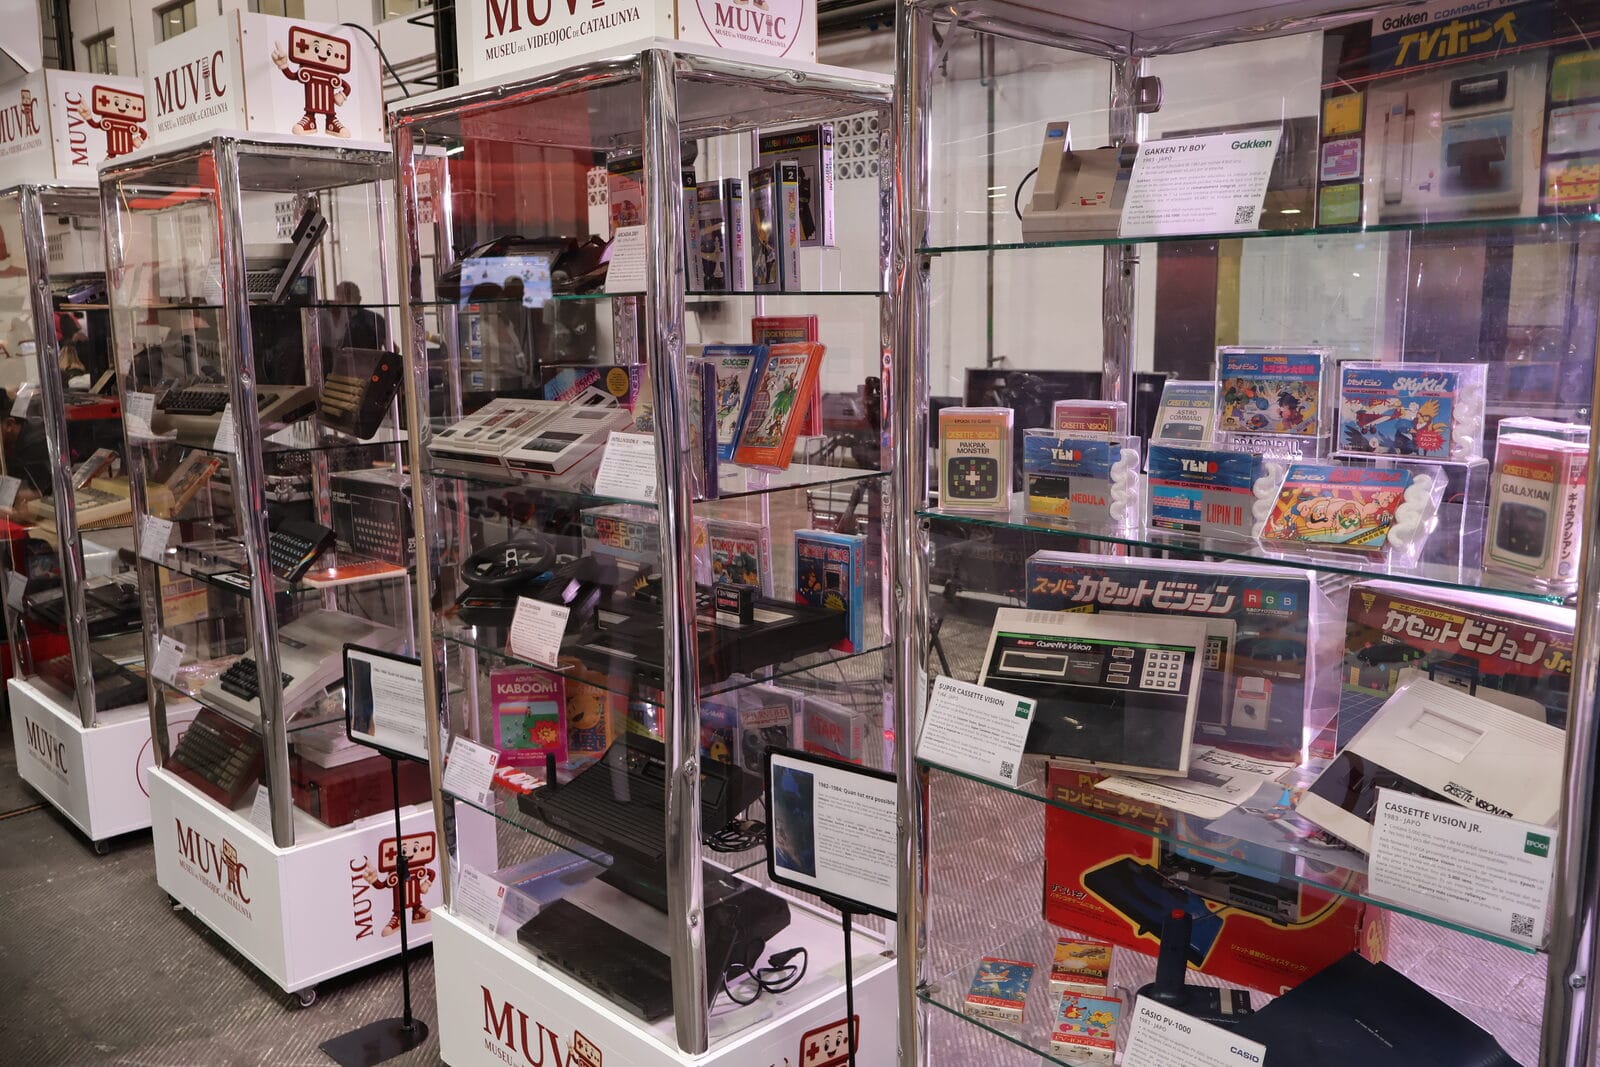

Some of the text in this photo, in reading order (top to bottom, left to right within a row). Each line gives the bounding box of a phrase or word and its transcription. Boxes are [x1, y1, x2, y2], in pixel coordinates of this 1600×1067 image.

[1382, 12, 1428, 31] Gakken
[485, 42, 517, 61] MUSEU
[527, 26, 572, 49] VIDEOJOC
[579, 6, 640, 36] CATALUNYA
[1144, 146, 1176, 156] GAKKEN
[1189, 143, 1206, 152] BOY
[1231, 139, 1272, 150] Gakken
[788, 171, 794, 180] 2
[1502, 483, 1551, 501] GALAXIAN
[1206, 503, 1243, 526] LUPIN III
[799, 543, 849, 562] DONKEY KONG
[1032, 577, 1075, 595] スーパー
[1071, 575, 1237, 614] カセットビジョン
[1248, 594, 1292, 606] R G B
[1068, 643, 1091, 651] Vision
[1381, 610, 1549, 665] カセットビジョン
[497, 681, 558, 695] KABOOM!
[939, 683, 1005, 707] SUPER CASSETTE VISION
[843, 787, 857, 797] Quan
[874, 795, 895, 806] possible
[1385, 802, 1482, 834] CASSETTE VISION JR.
[350, 855, 374, 941] MUVIC
[1140, 1007, 1191, 1035] CASIO PV-1000
[484, 1038, 513, 1066] MUSEU
[1229, 1046, 1260, 1063] CASIO
